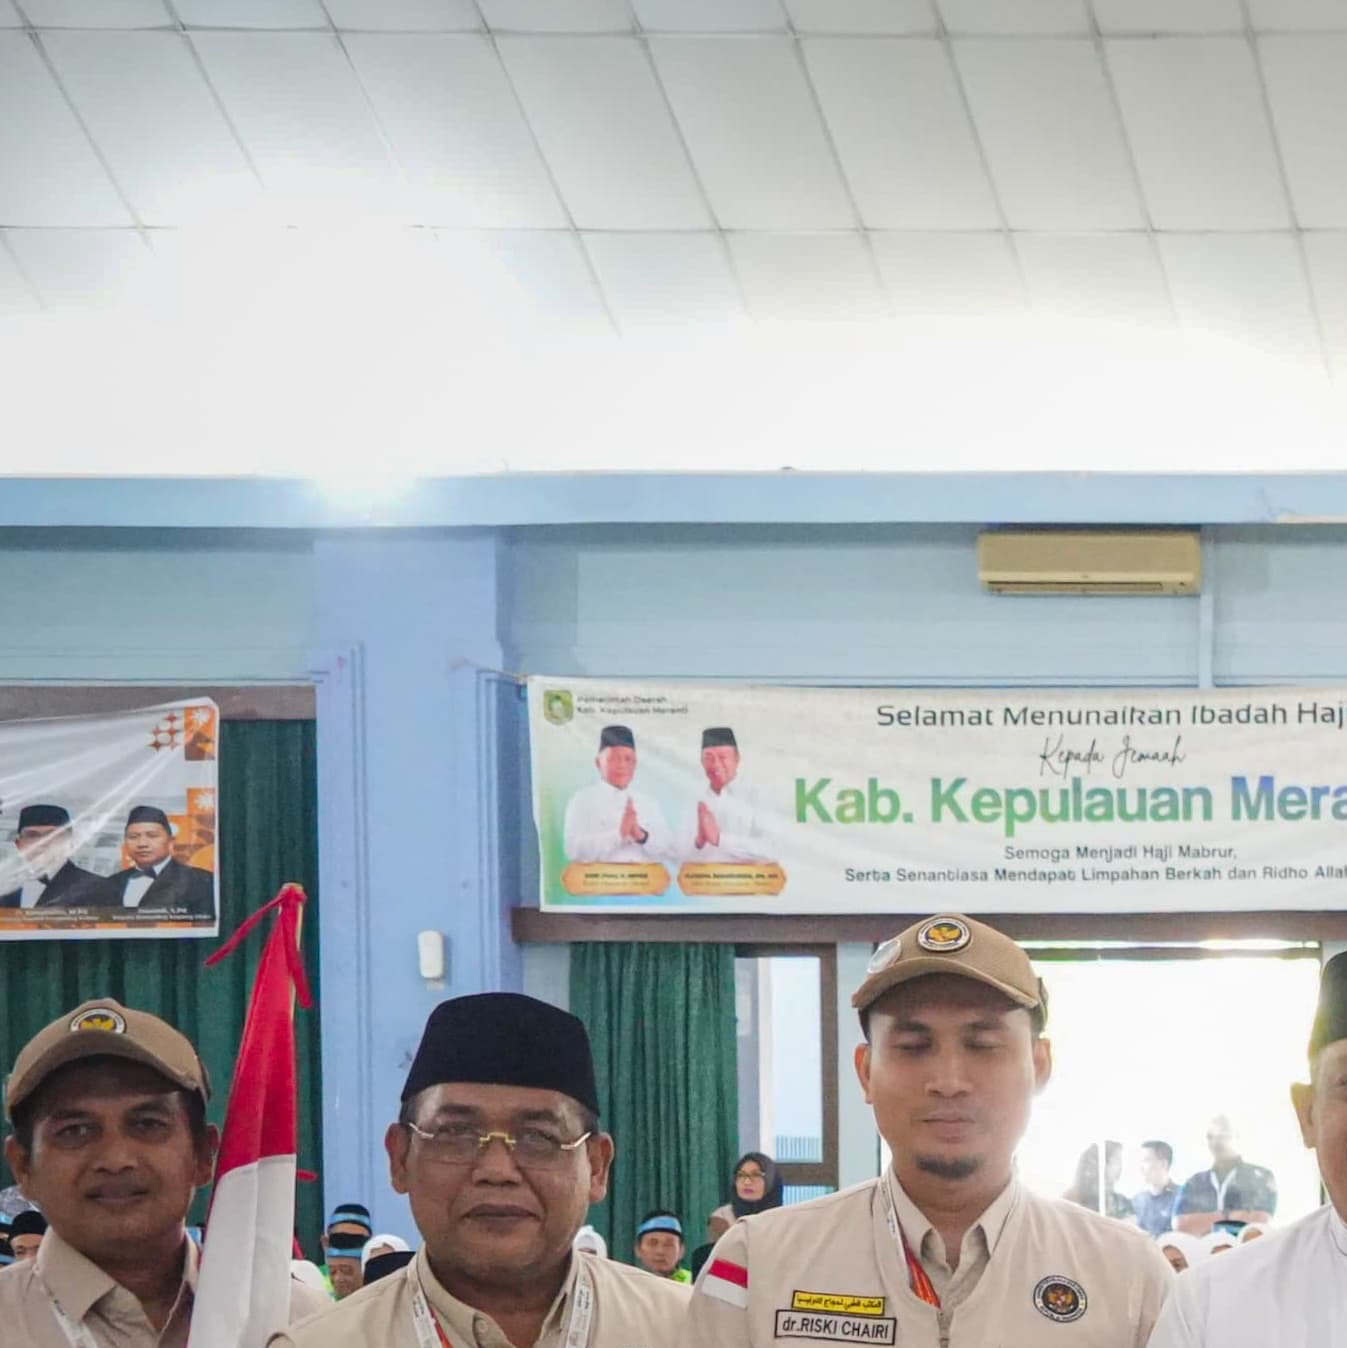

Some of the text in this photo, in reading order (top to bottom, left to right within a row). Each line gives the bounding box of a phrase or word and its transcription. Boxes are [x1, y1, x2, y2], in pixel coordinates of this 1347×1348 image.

[877, 705, 993, 726] Selamat
[1003, 706, 1181, 726] Menunaikan
[1192, 704, 1288, 724] Ibadah
[1040, 734, 1105, 779] Kepada
[795, 777, 913, 824] Kab.
[930, 777, 1213, 838] Kepulauan
[1004, 847, 1070, 862] Semoga
[1076, 845, 1138, 864] Menjadi
[1143, 845, 1173, 864] Haji
[845, 868, 891, 882] Serta
[896, 868, 988, 882] Senantiasa
[994, 868, 1077, 885] Mendapat
[1082, 867, 1160, 885] Limpahan
[1165, 866, 1222, 881] Berkah
[1228, 866, 1257, 880] dan
[1263, 865, 1308, 880] Ridho
[841, 1320, 889, 1339] CHAIRI
